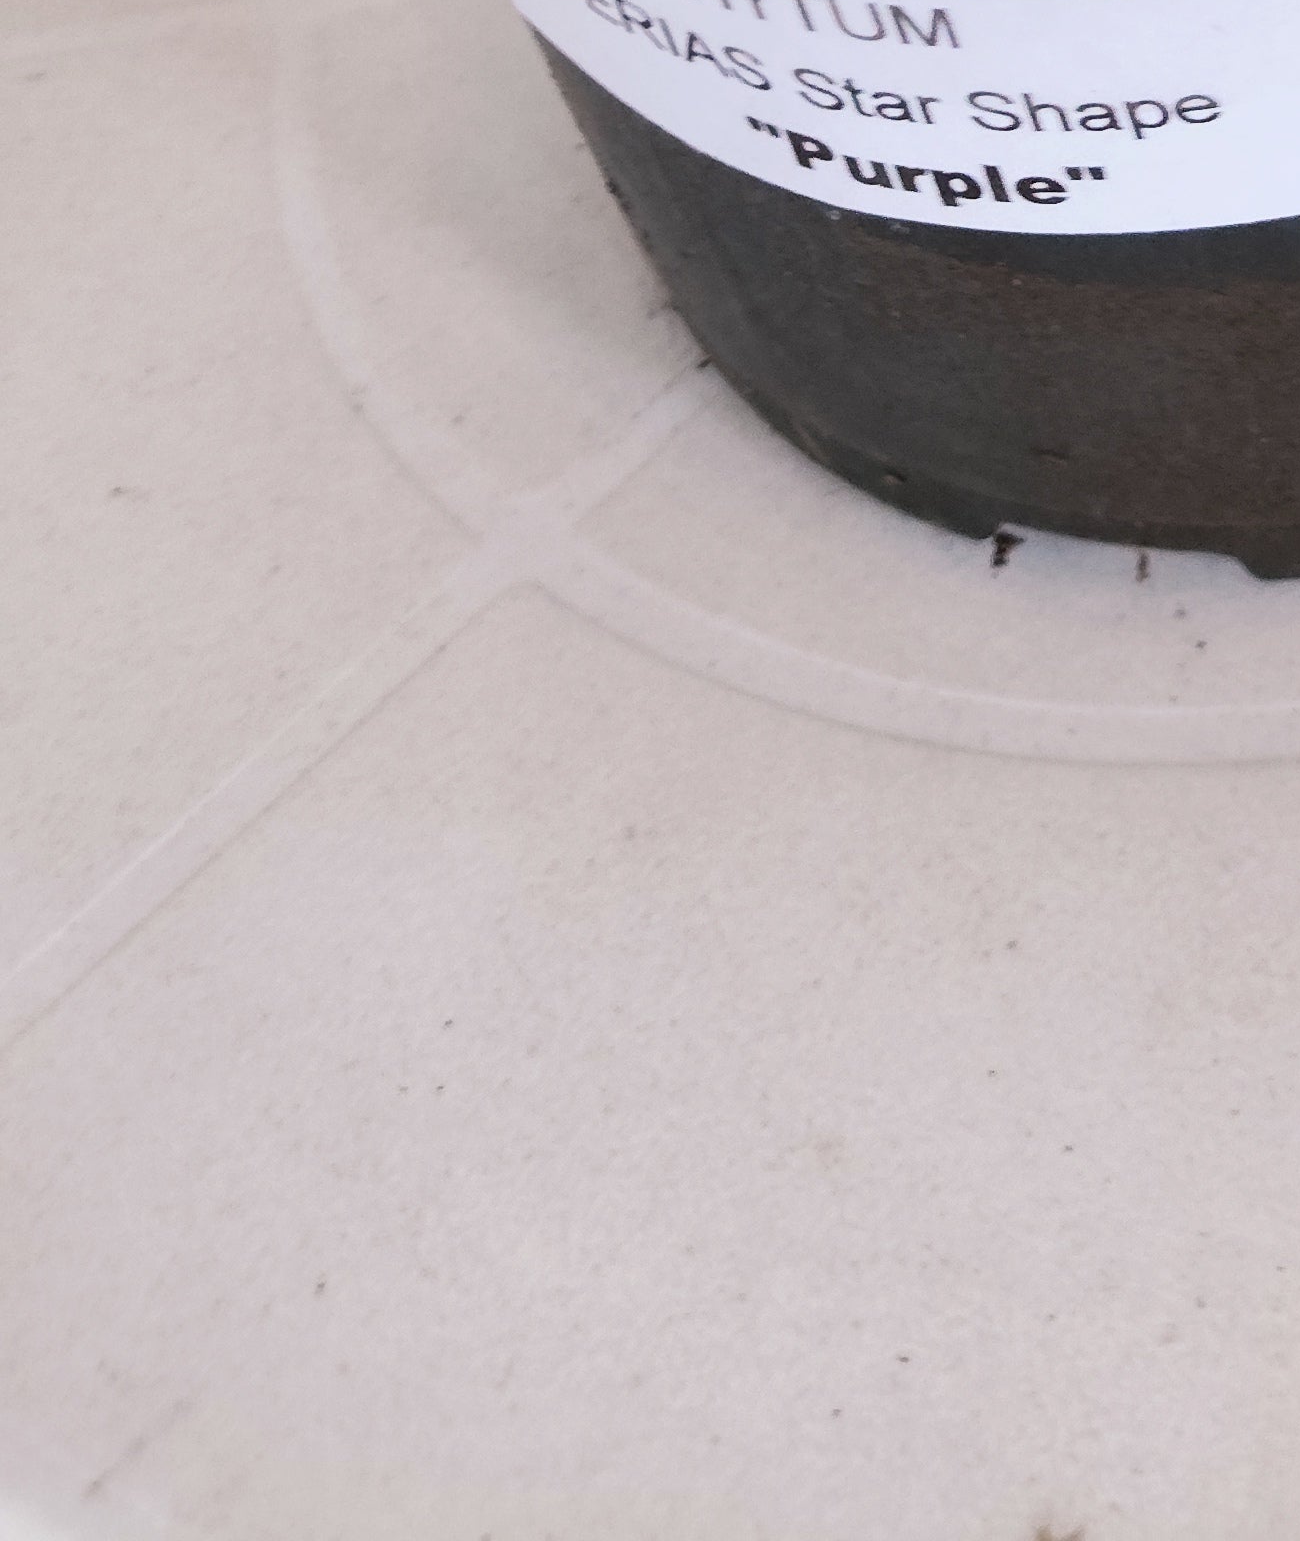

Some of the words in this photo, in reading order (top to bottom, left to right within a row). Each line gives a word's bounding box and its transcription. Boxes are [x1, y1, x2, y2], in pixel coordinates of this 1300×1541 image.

[793, 67, 940, 126] Star
[968, 89, 1223, 140] Shape
[746, 115, 1106, 208] "Purple"
